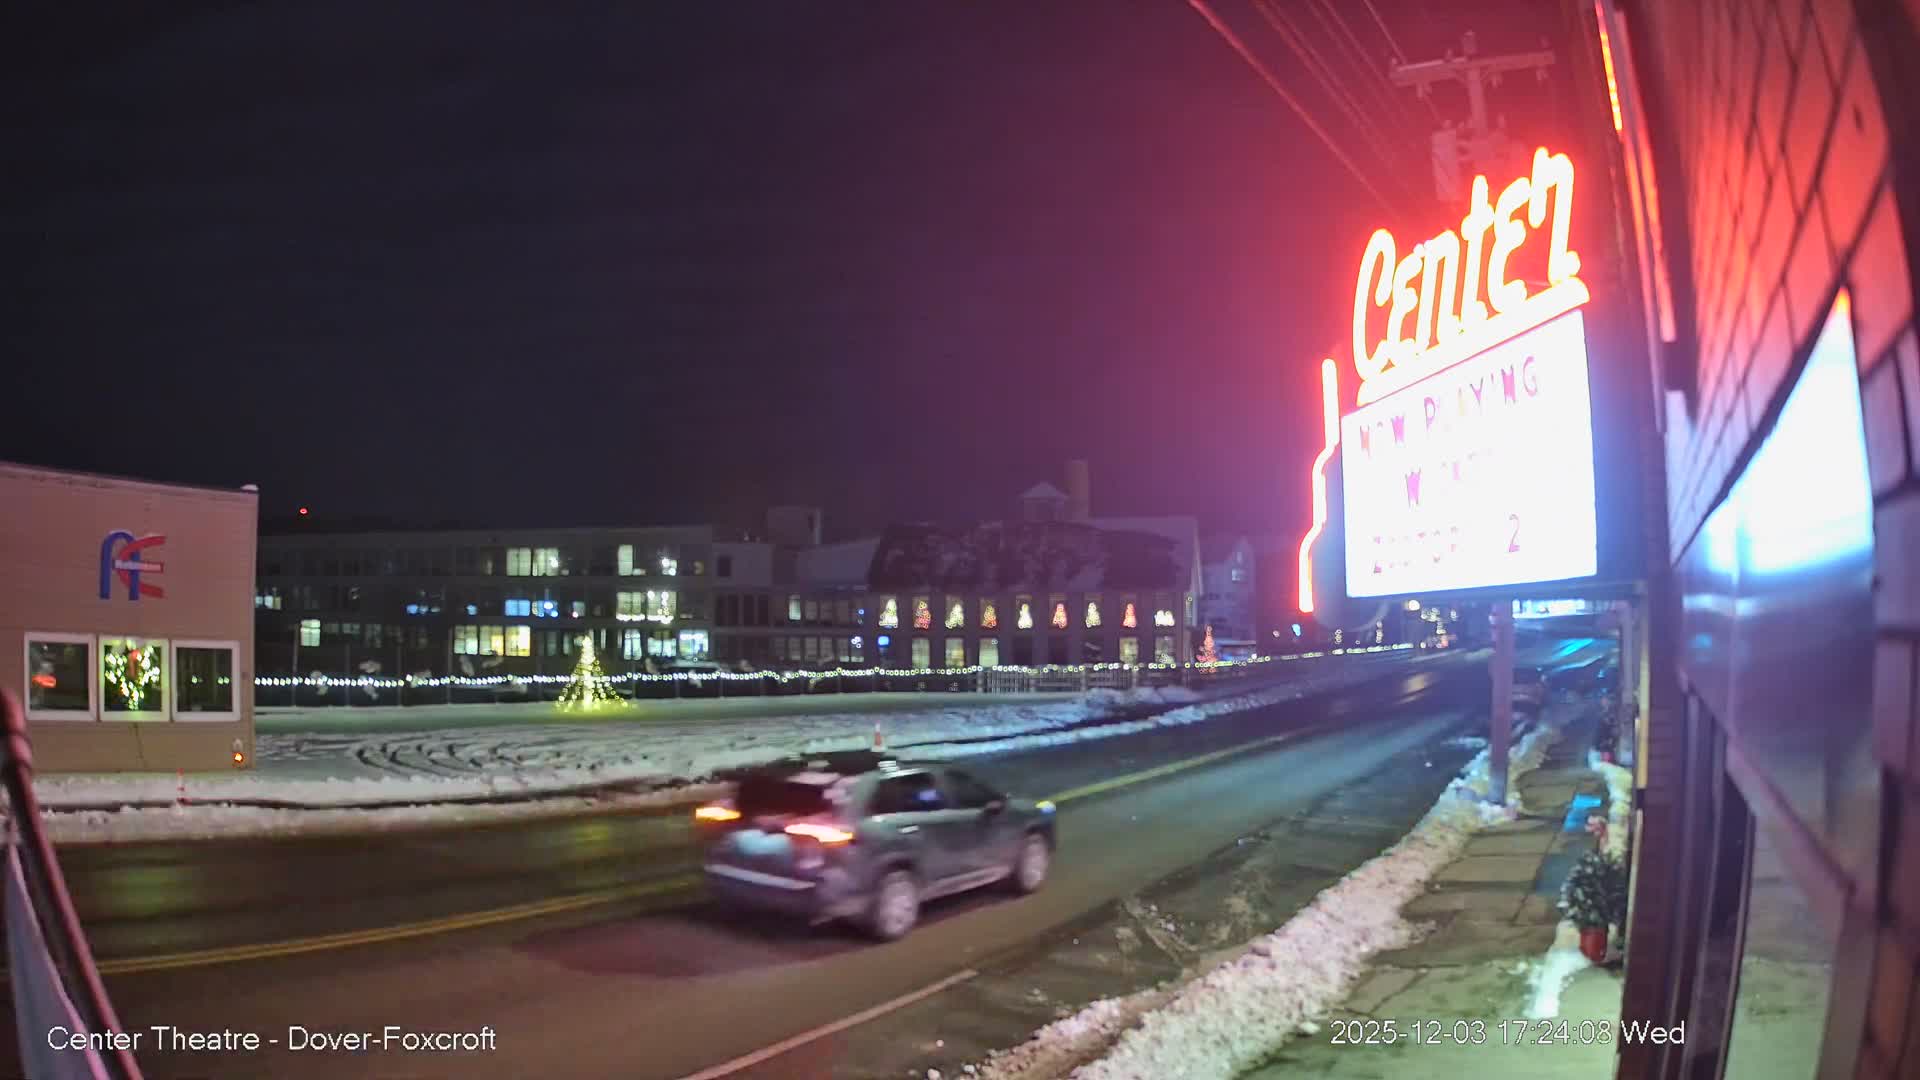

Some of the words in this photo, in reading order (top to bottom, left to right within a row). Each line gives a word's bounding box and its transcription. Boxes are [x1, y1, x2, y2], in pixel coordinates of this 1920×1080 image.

[1360, 413, 1405, 459] NW
[1423, 356, 1538, 434] PYNG
[1507, 513, 1521, 553] 2
